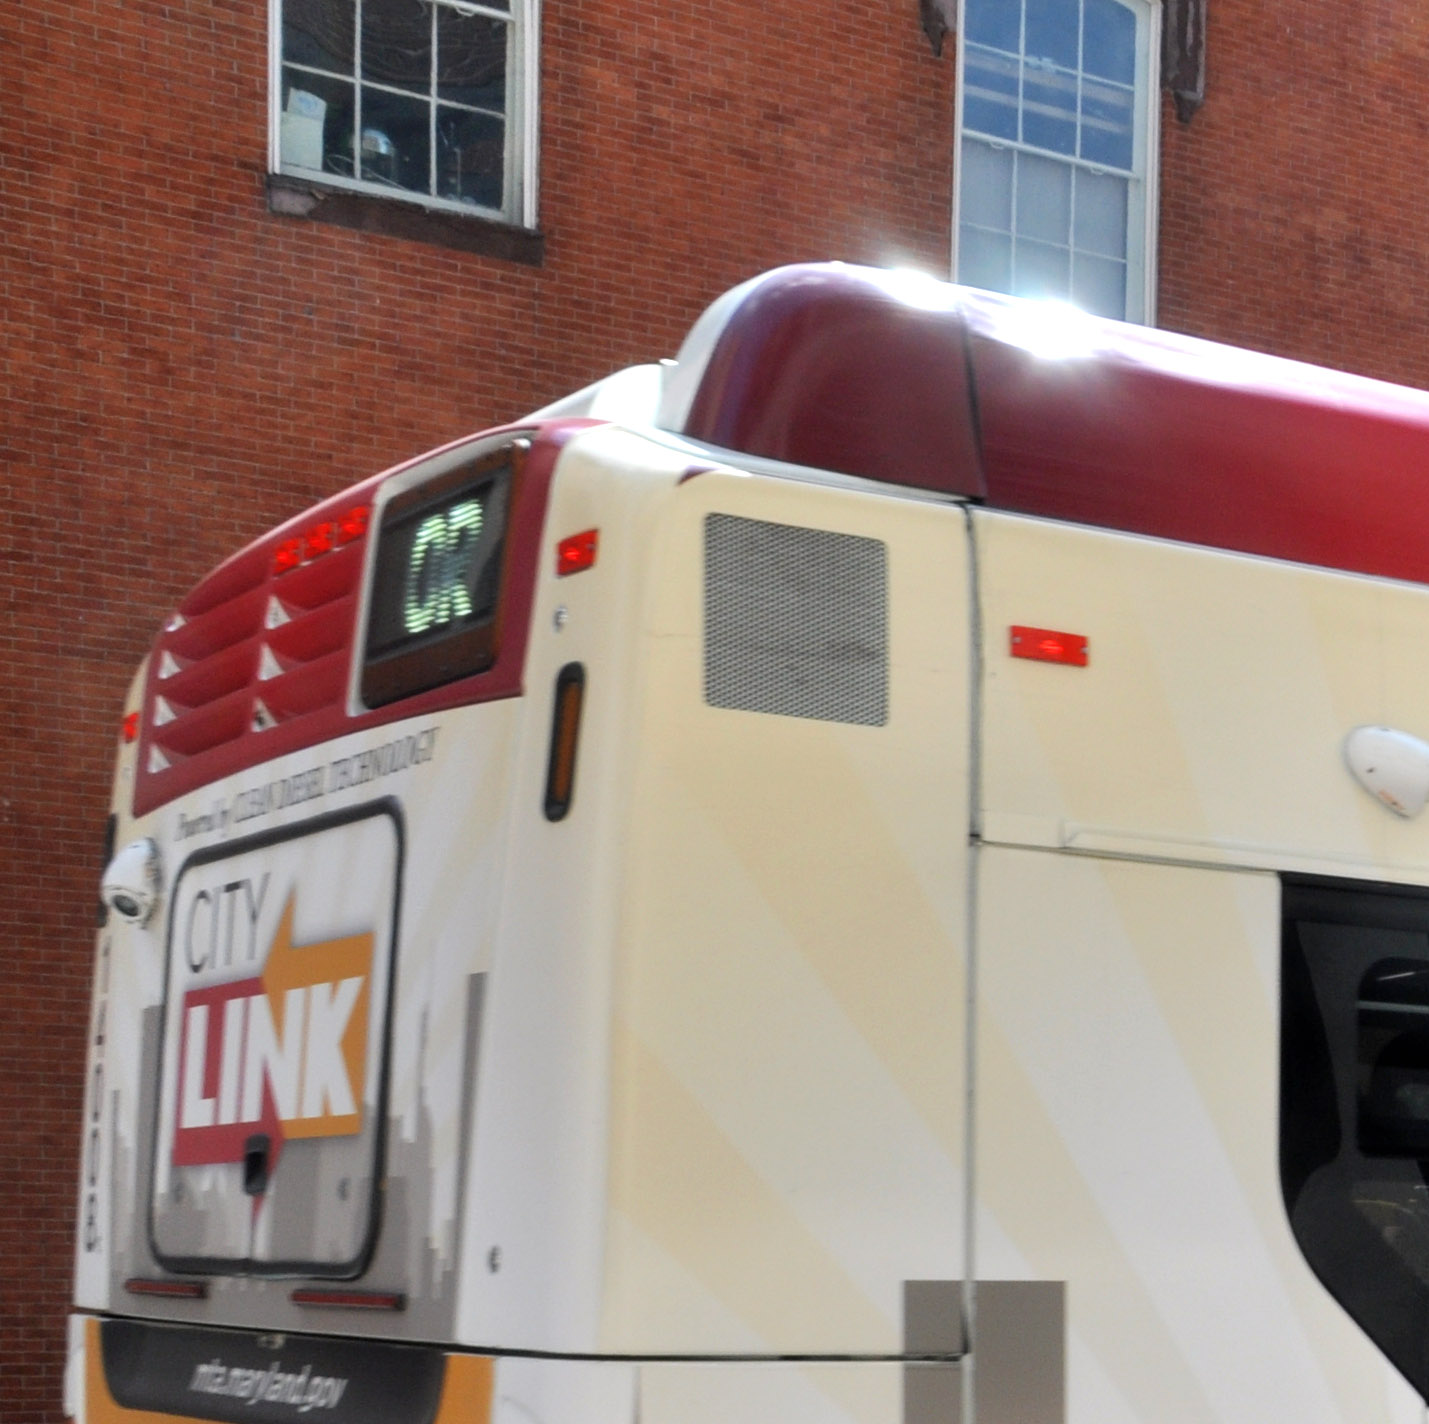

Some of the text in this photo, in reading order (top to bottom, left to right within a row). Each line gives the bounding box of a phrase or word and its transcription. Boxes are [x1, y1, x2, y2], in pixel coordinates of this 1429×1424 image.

[187, 872, 271, 973] CITY
[180, 975, 367, 1129] LINK
[189, 1358, 349, 1413] mta.maryland.gov
